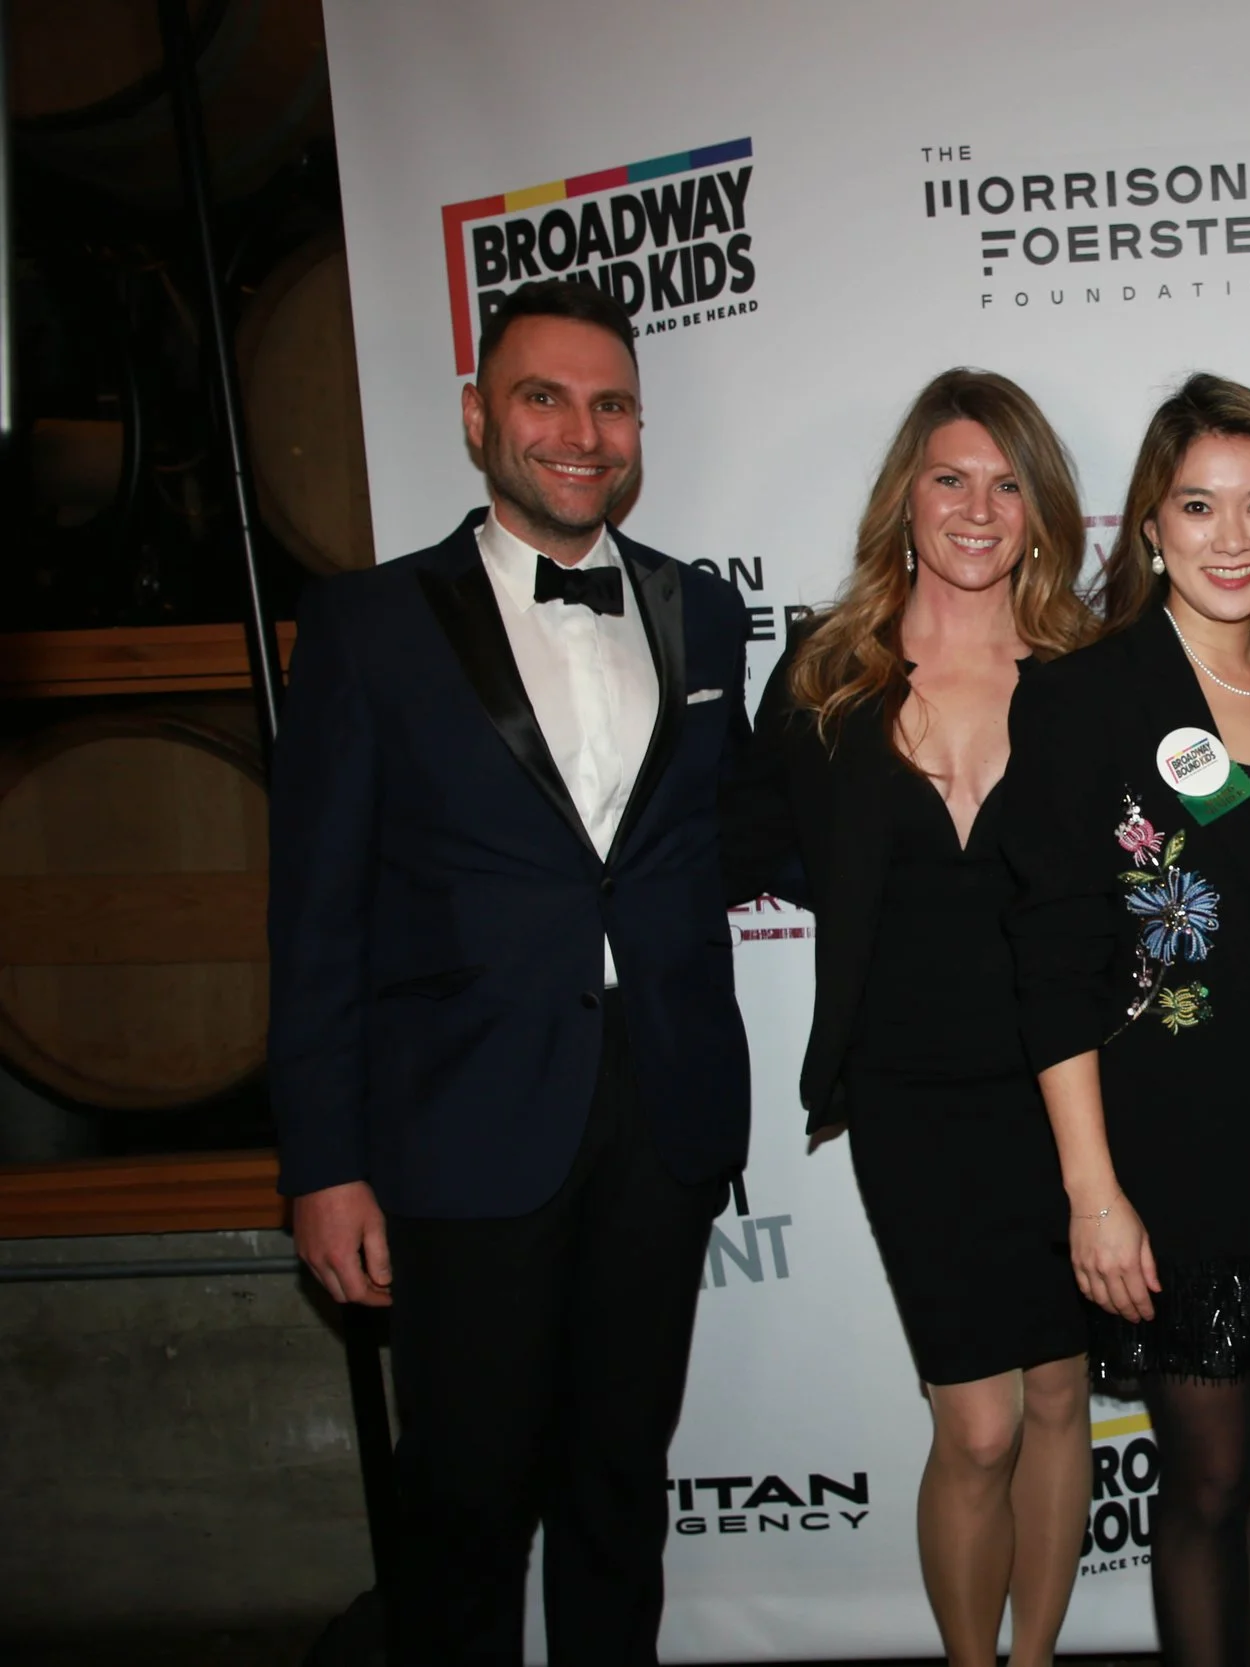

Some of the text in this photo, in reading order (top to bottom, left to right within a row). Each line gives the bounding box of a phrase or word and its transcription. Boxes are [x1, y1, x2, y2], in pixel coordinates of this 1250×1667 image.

[921, 145, 971, 162] THE
[925, 163, 1247, 217] MORRISON
[472, 165, 753, 287] BROADWAY
[648, 233, 756, 312] KIDS
[645, 319, 677, 335] AND
[683, 312, 701, 327] BE
[707, 300, 758, 321] HEARD
[1171, 742, 1210, 770] BROADWAY
[1176, 760, 1200, 778] BOUND
[1200, 751, 1216, 767] KIDS
[700, 1214, 792, 1290] NT
[667, 1472, 869, 1511] ITAN
[1081, 1553, 1152, 1576] PLACE TO
